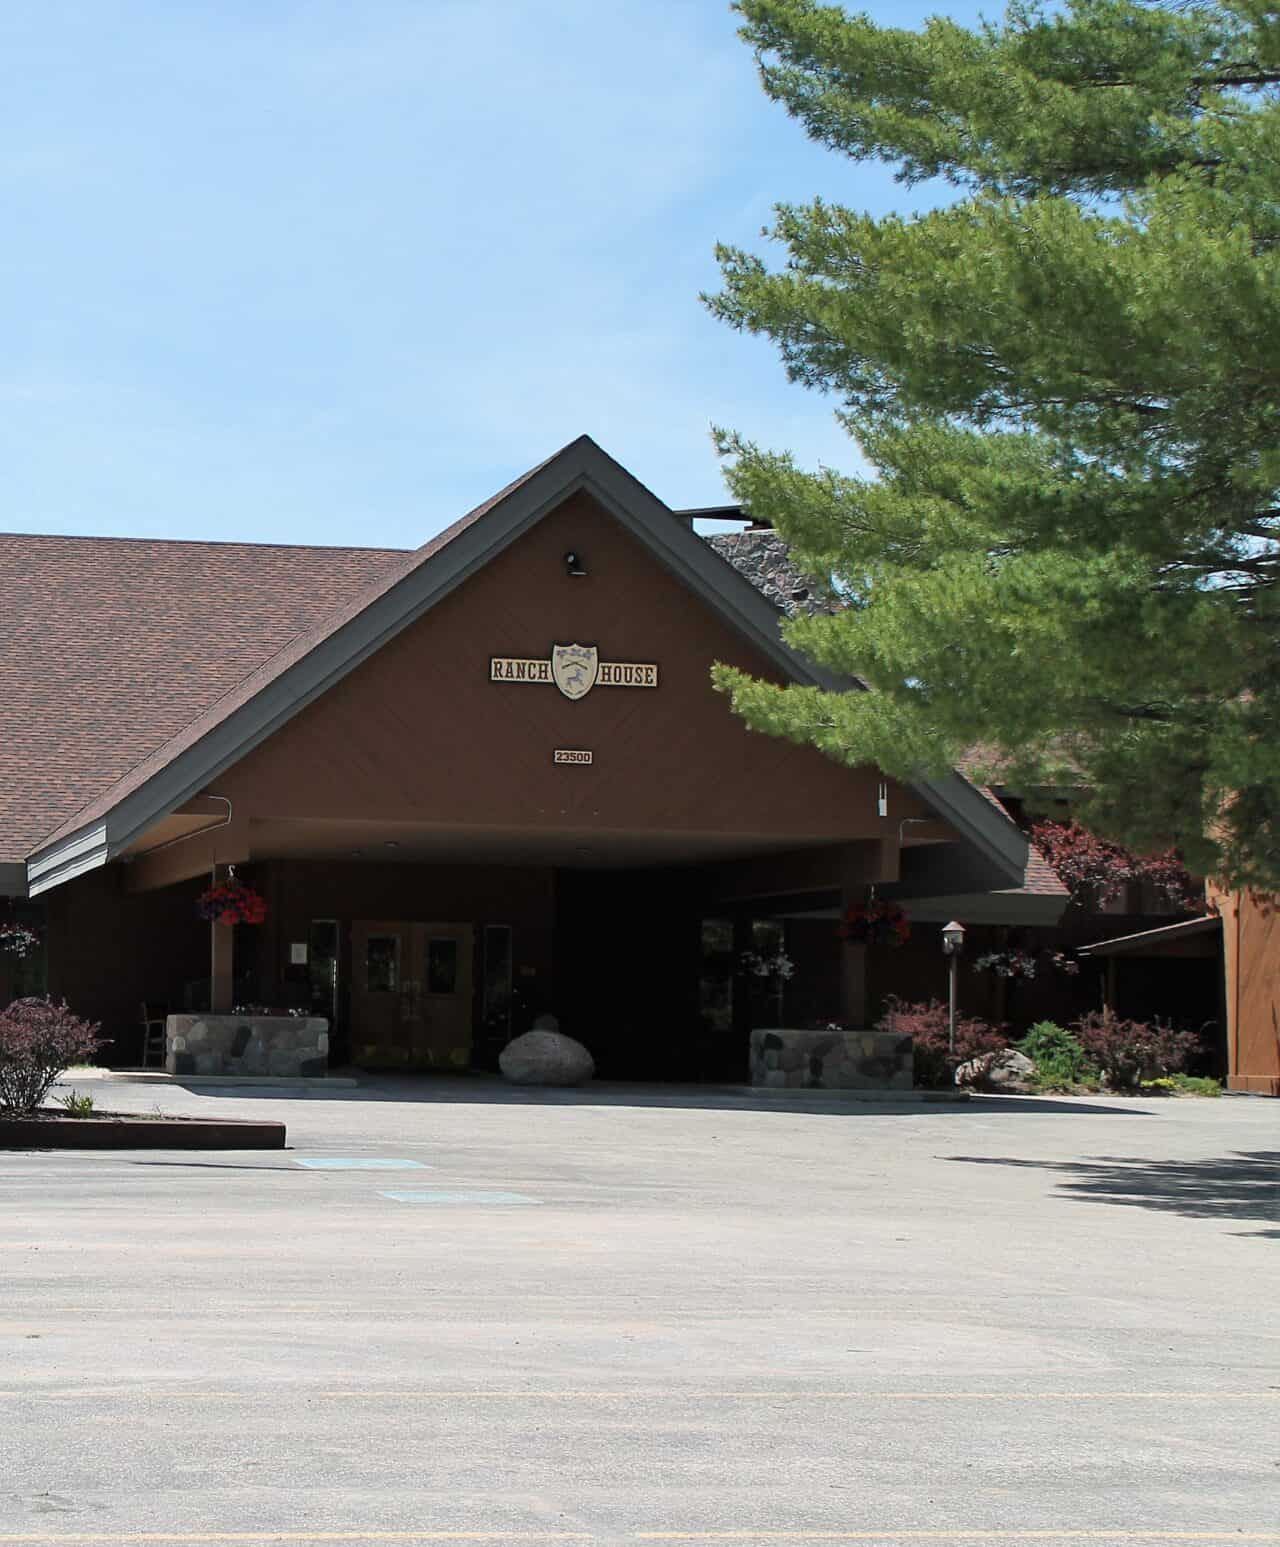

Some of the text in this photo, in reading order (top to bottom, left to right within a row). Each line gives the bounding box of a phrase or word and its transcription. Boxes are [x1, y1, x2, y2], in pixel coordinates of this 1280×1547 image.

[493, 660, 654, 684] RANCH HOUSE
[556, 751, 591, 762] 23500
